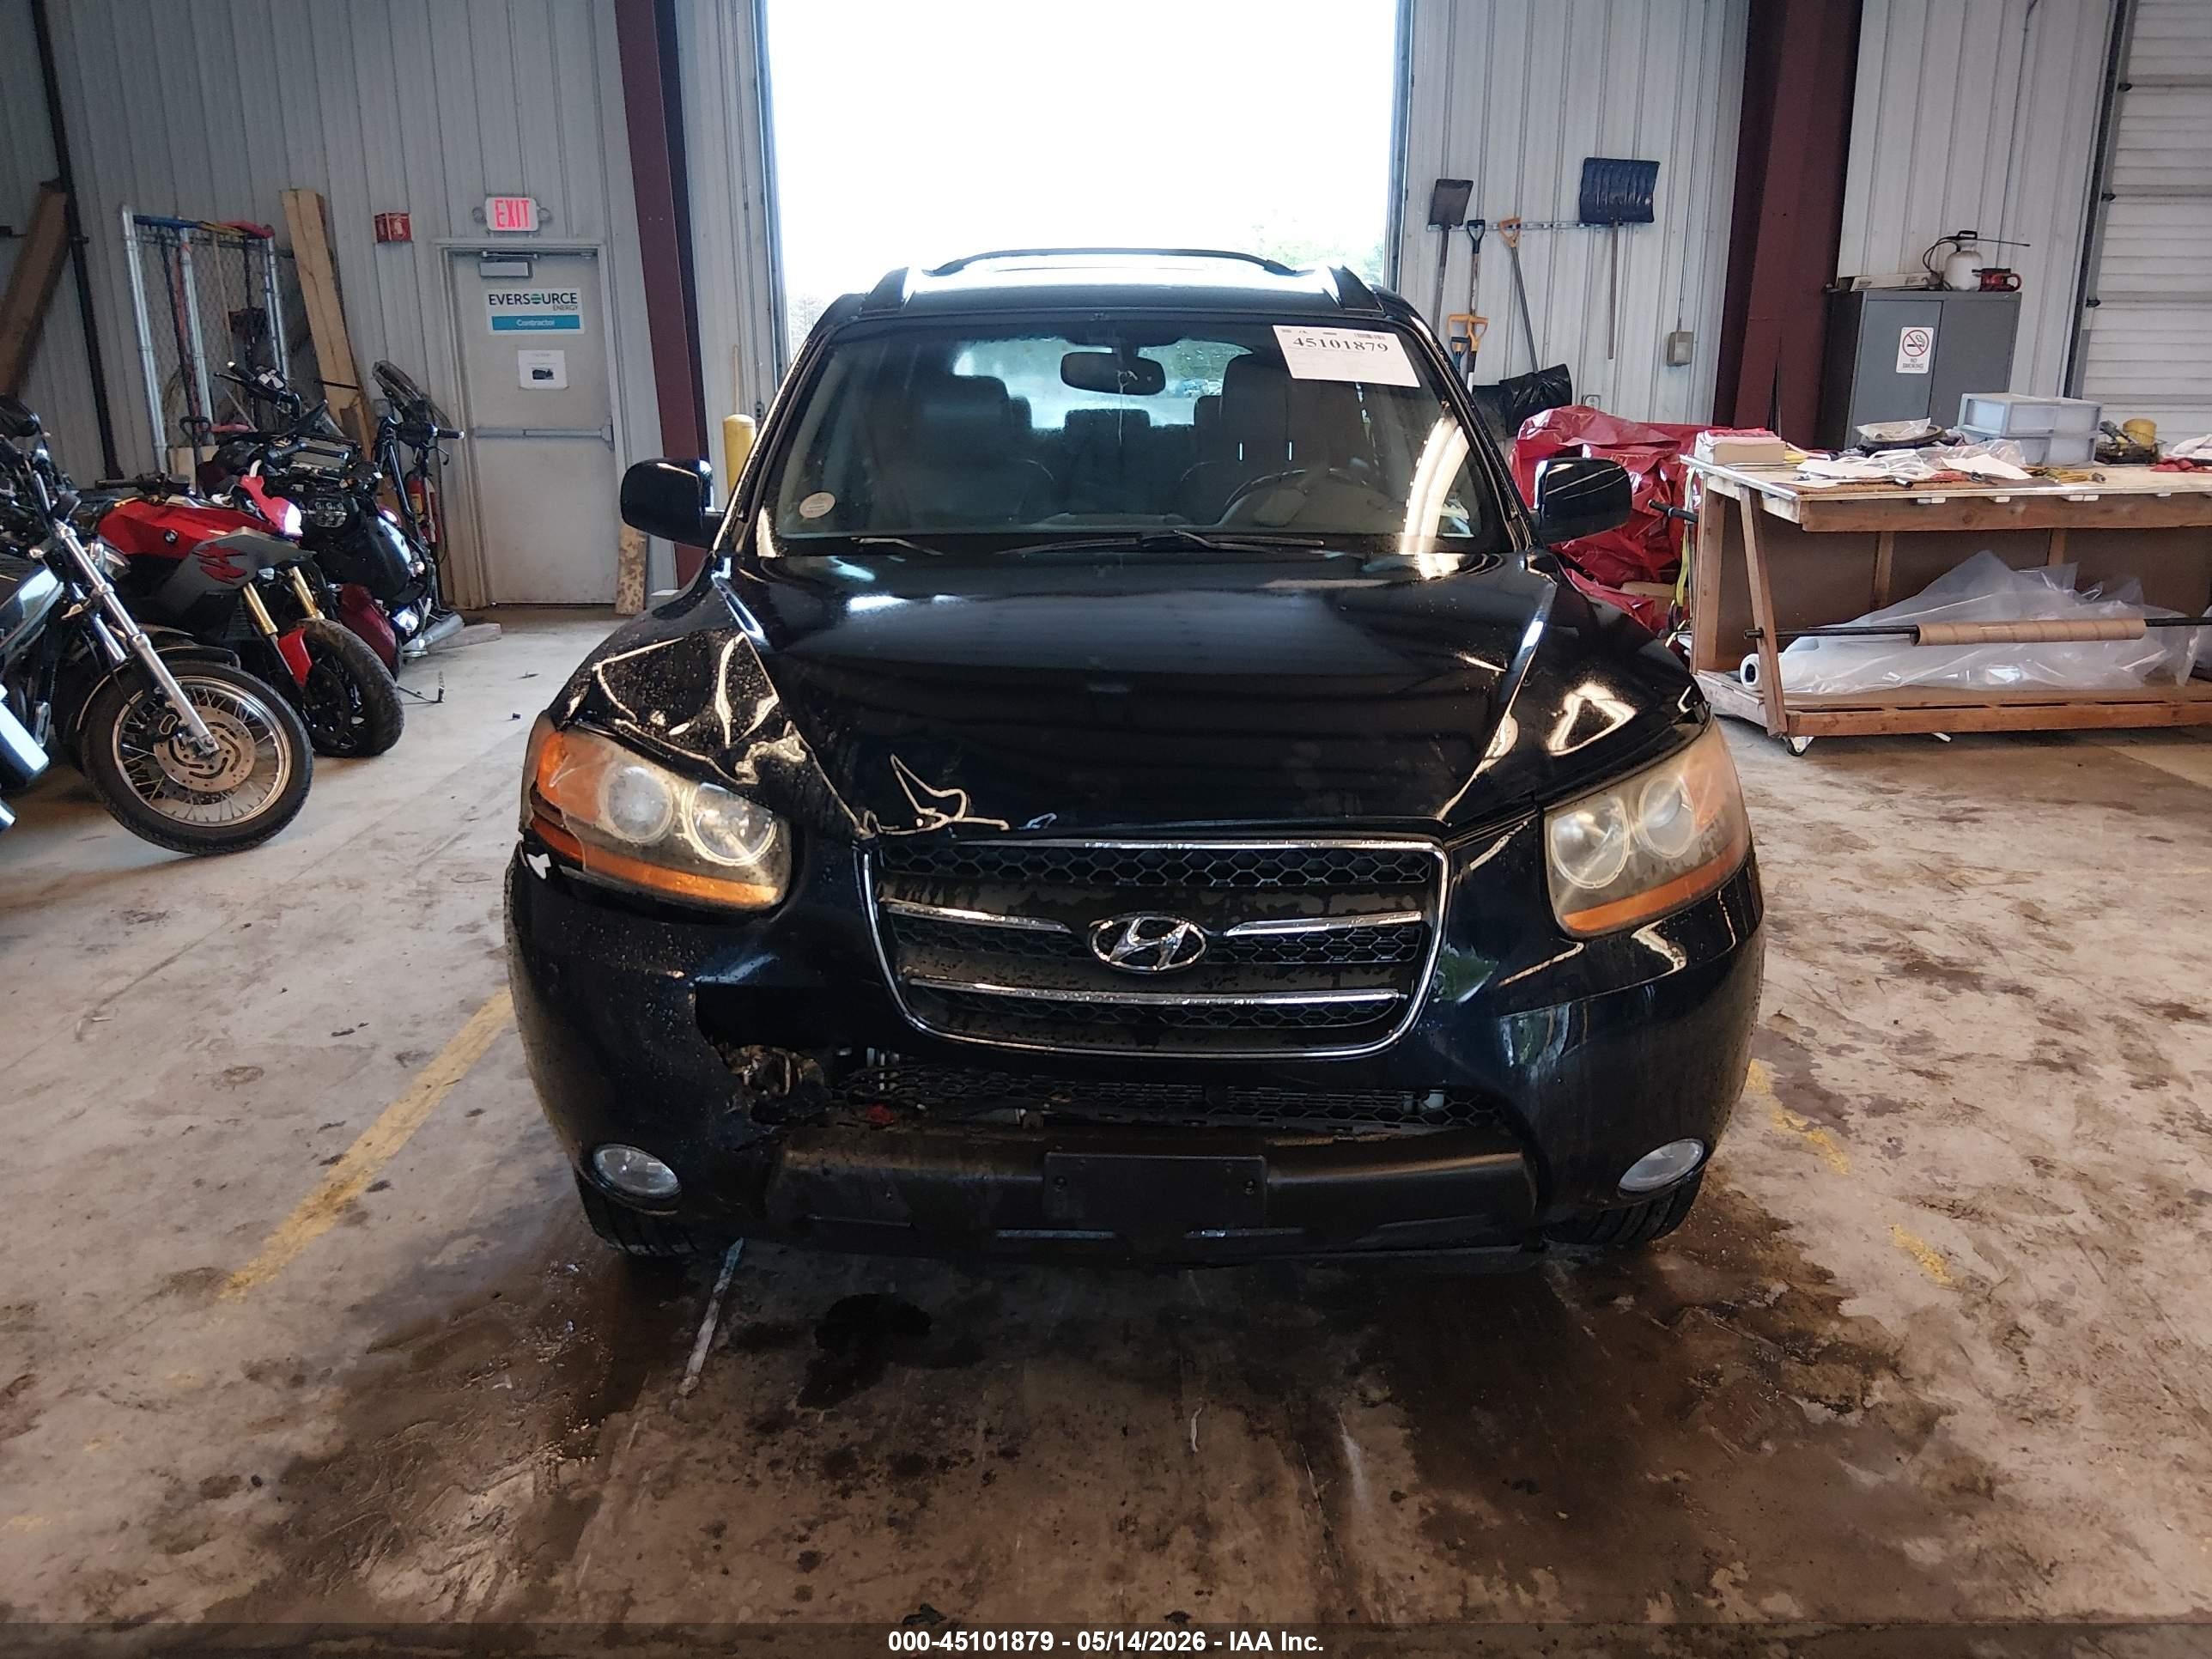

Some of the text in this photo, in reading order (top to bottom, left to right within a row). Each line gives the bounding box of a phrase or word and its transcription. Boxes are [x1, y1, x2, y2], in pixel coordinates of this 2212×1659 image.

[495, 200, 529, 228] EXIT
[489, 293, 578, 306] EVERSOURCE
[1292, 337, 1389, 352] 45101879
